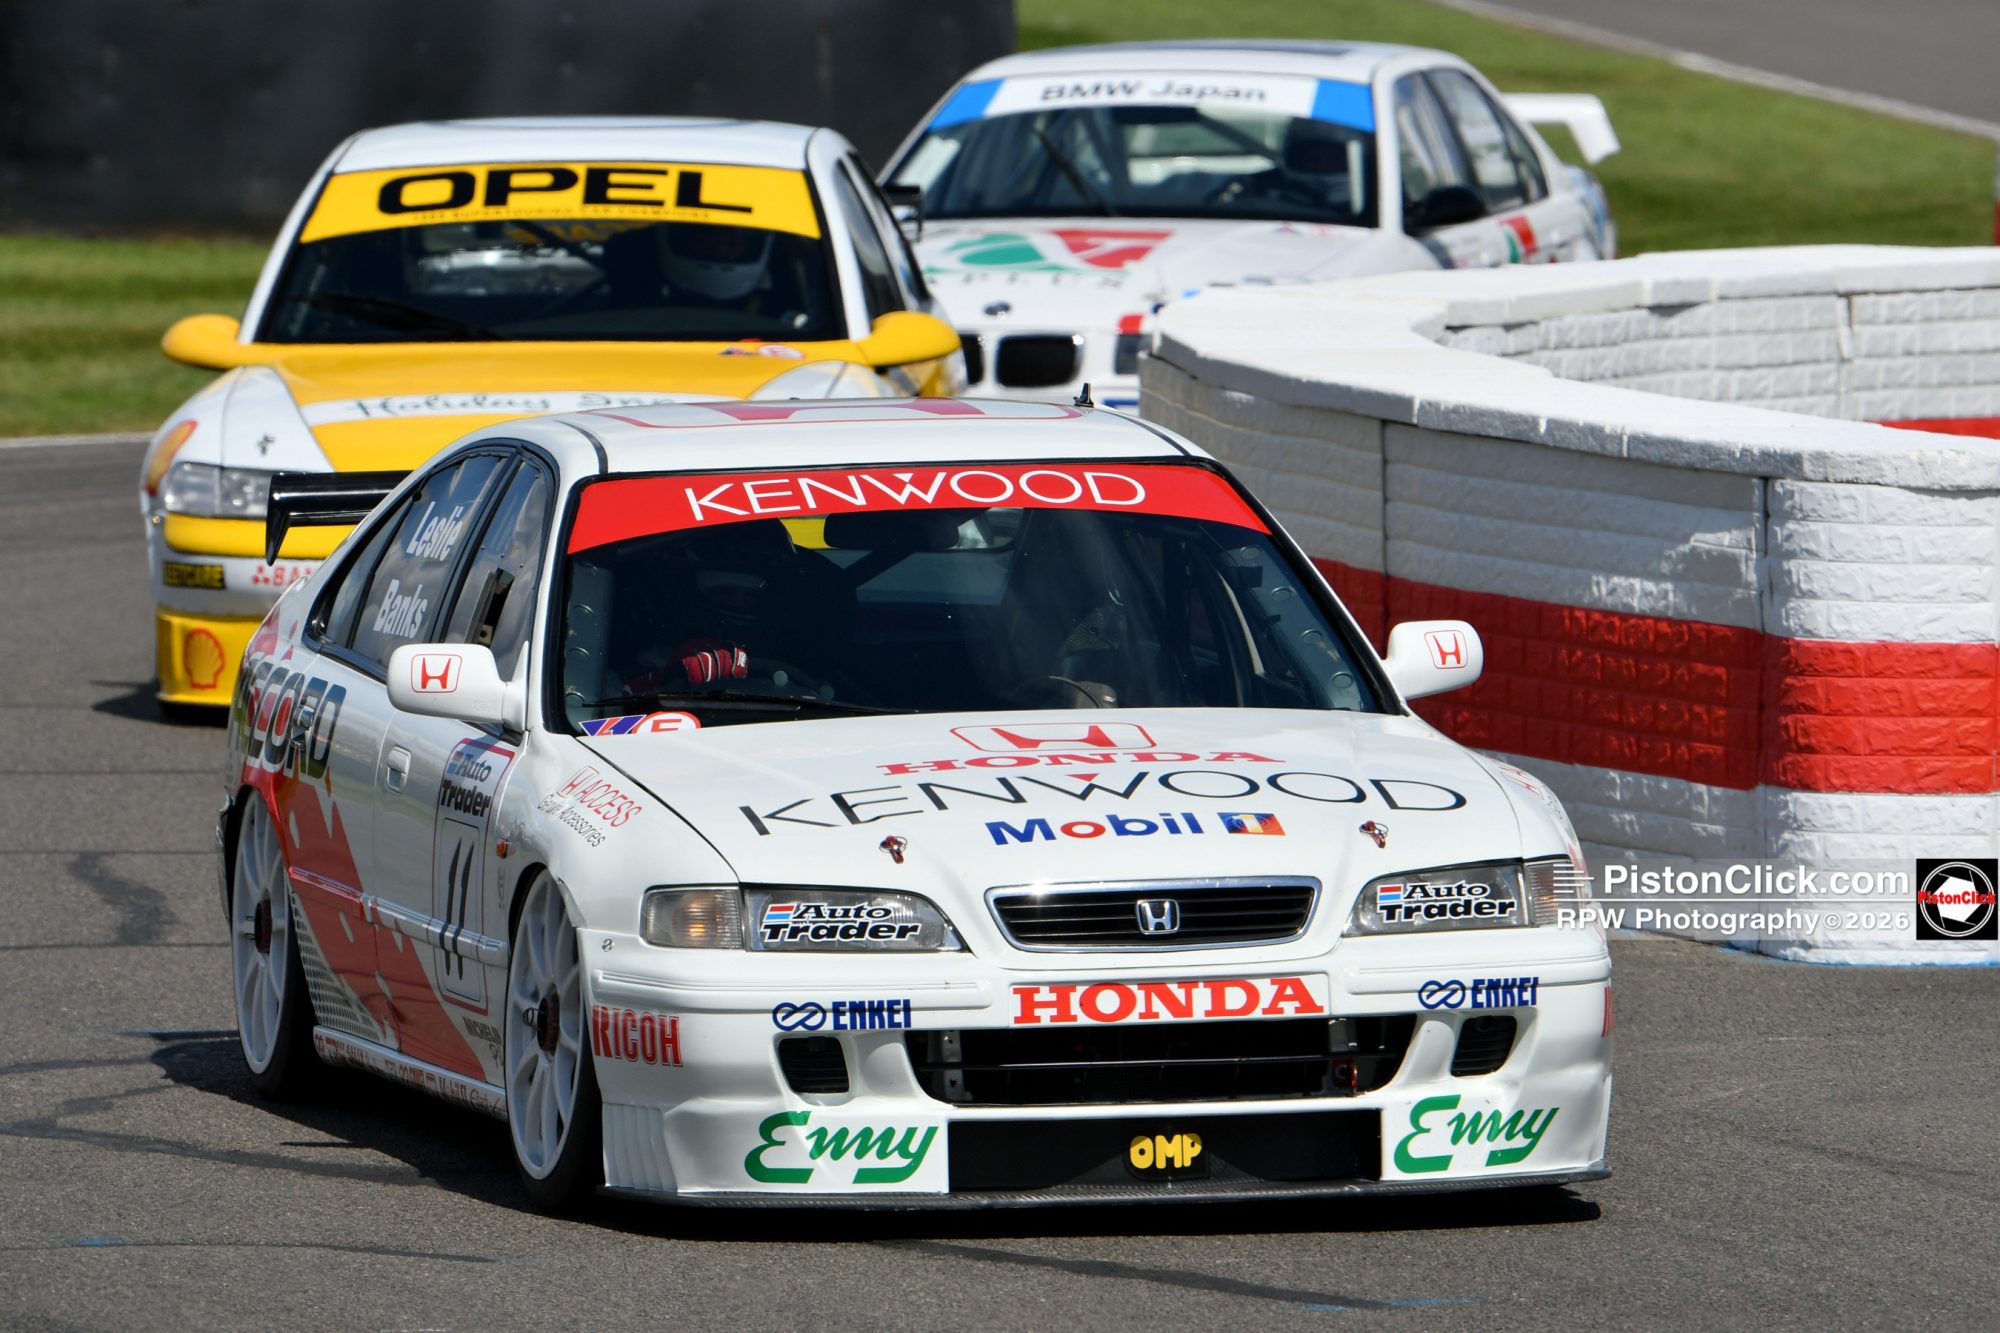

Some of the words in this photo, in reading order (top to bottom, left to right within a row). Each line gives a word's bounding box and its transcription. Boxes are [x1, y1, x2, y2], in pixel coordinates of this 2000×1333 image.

[1041, 81, 1142, 101] BMW
[1149, 80, 1268, 101] Japan
[378, 167, 752, 214] OPEL
[352, 394, 550, 418] Holiday
[684, 469, 1147, 521] KENWOOD
[406, 500, 465, 562] Leslie
[372, 578, 429, 640] Banks
[456, 753, 492, 783] Auto
[877, 752, 1285, 777] HONDA
[441, 779, 492, 818] Trader
[573, 779, 645, 828] ACCESS
[740, 771, 1467, 836] KENWOOD
[986, 813, 1204, 846] Mobil
[1403, 882, 1489, 899] Auto
[439, 839, 475, 981] 11
[793, 901, 892, 921] Auto
[1379, 899, 1516, 921] Trader
[761, 920, 920, 942] Trader
[1013, 978, 1324, 1024] HONDA
[1471, 977, 1539, 1009] ENKEI
[833, 999, 912, 1030] ENKEI
[592, 1004, 684, 1068] RICOH
[1129, 1131, 1203, 1170] OMP
